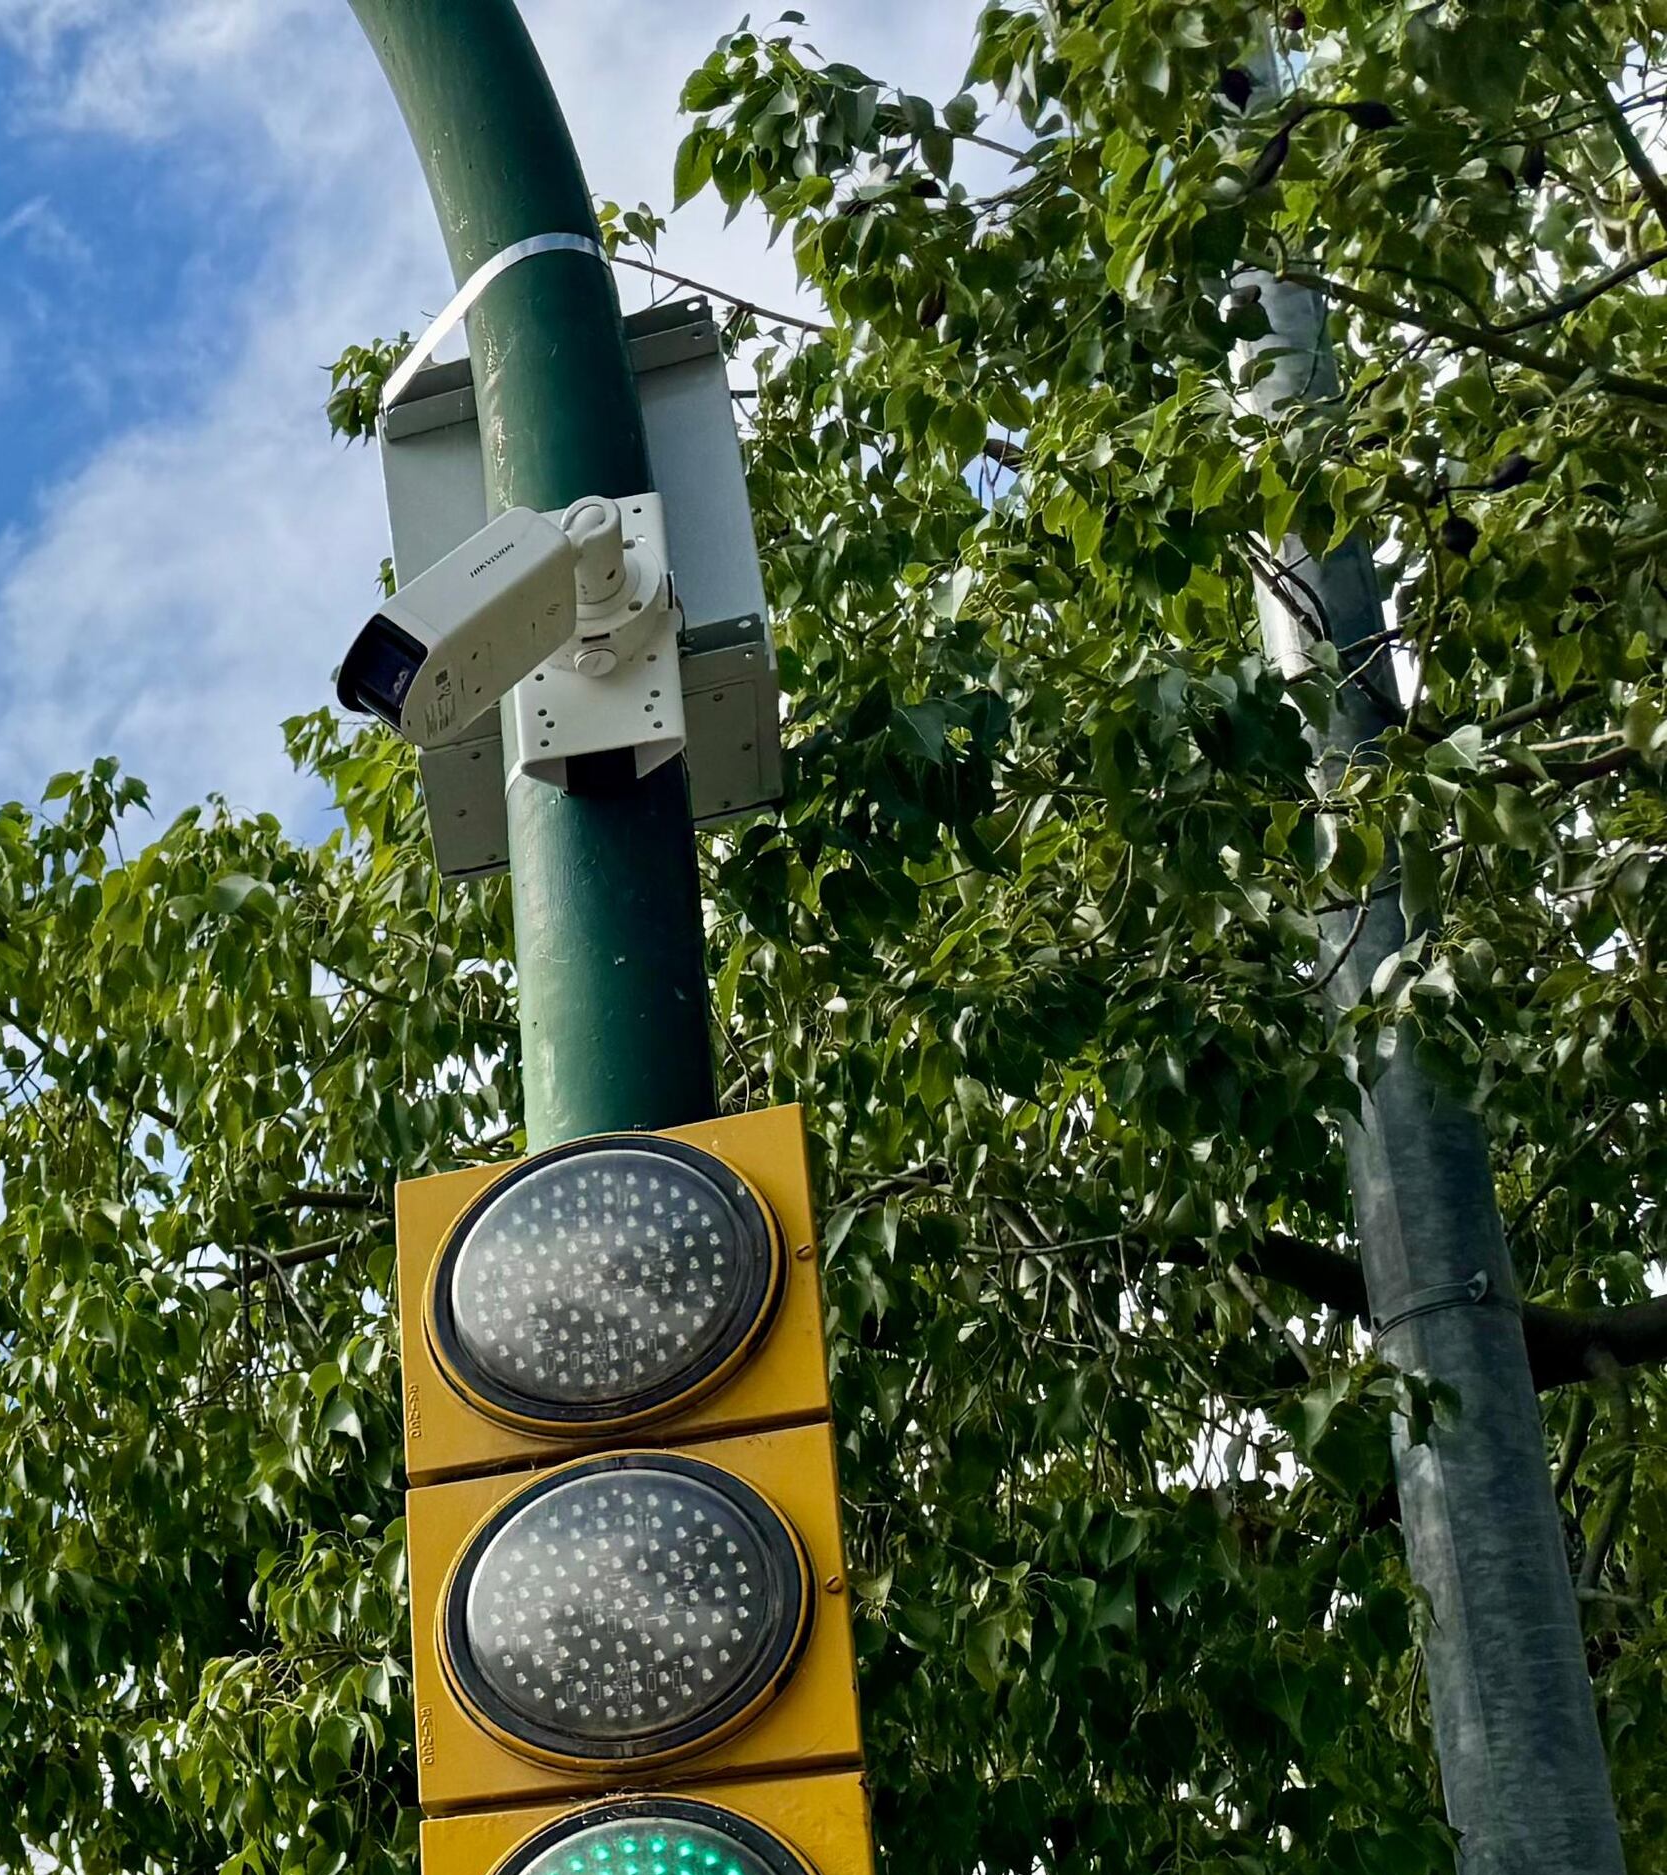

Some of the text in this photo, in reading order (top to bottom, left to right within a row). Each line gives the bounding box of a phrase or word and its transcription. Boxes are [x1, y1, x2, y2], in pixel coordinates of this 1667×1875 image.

[470, 542, 515, 578] HIKVISION
[408, 1384, 422, 1439] SAINCO
[419, 1706, 434, 1765] SAINCO
